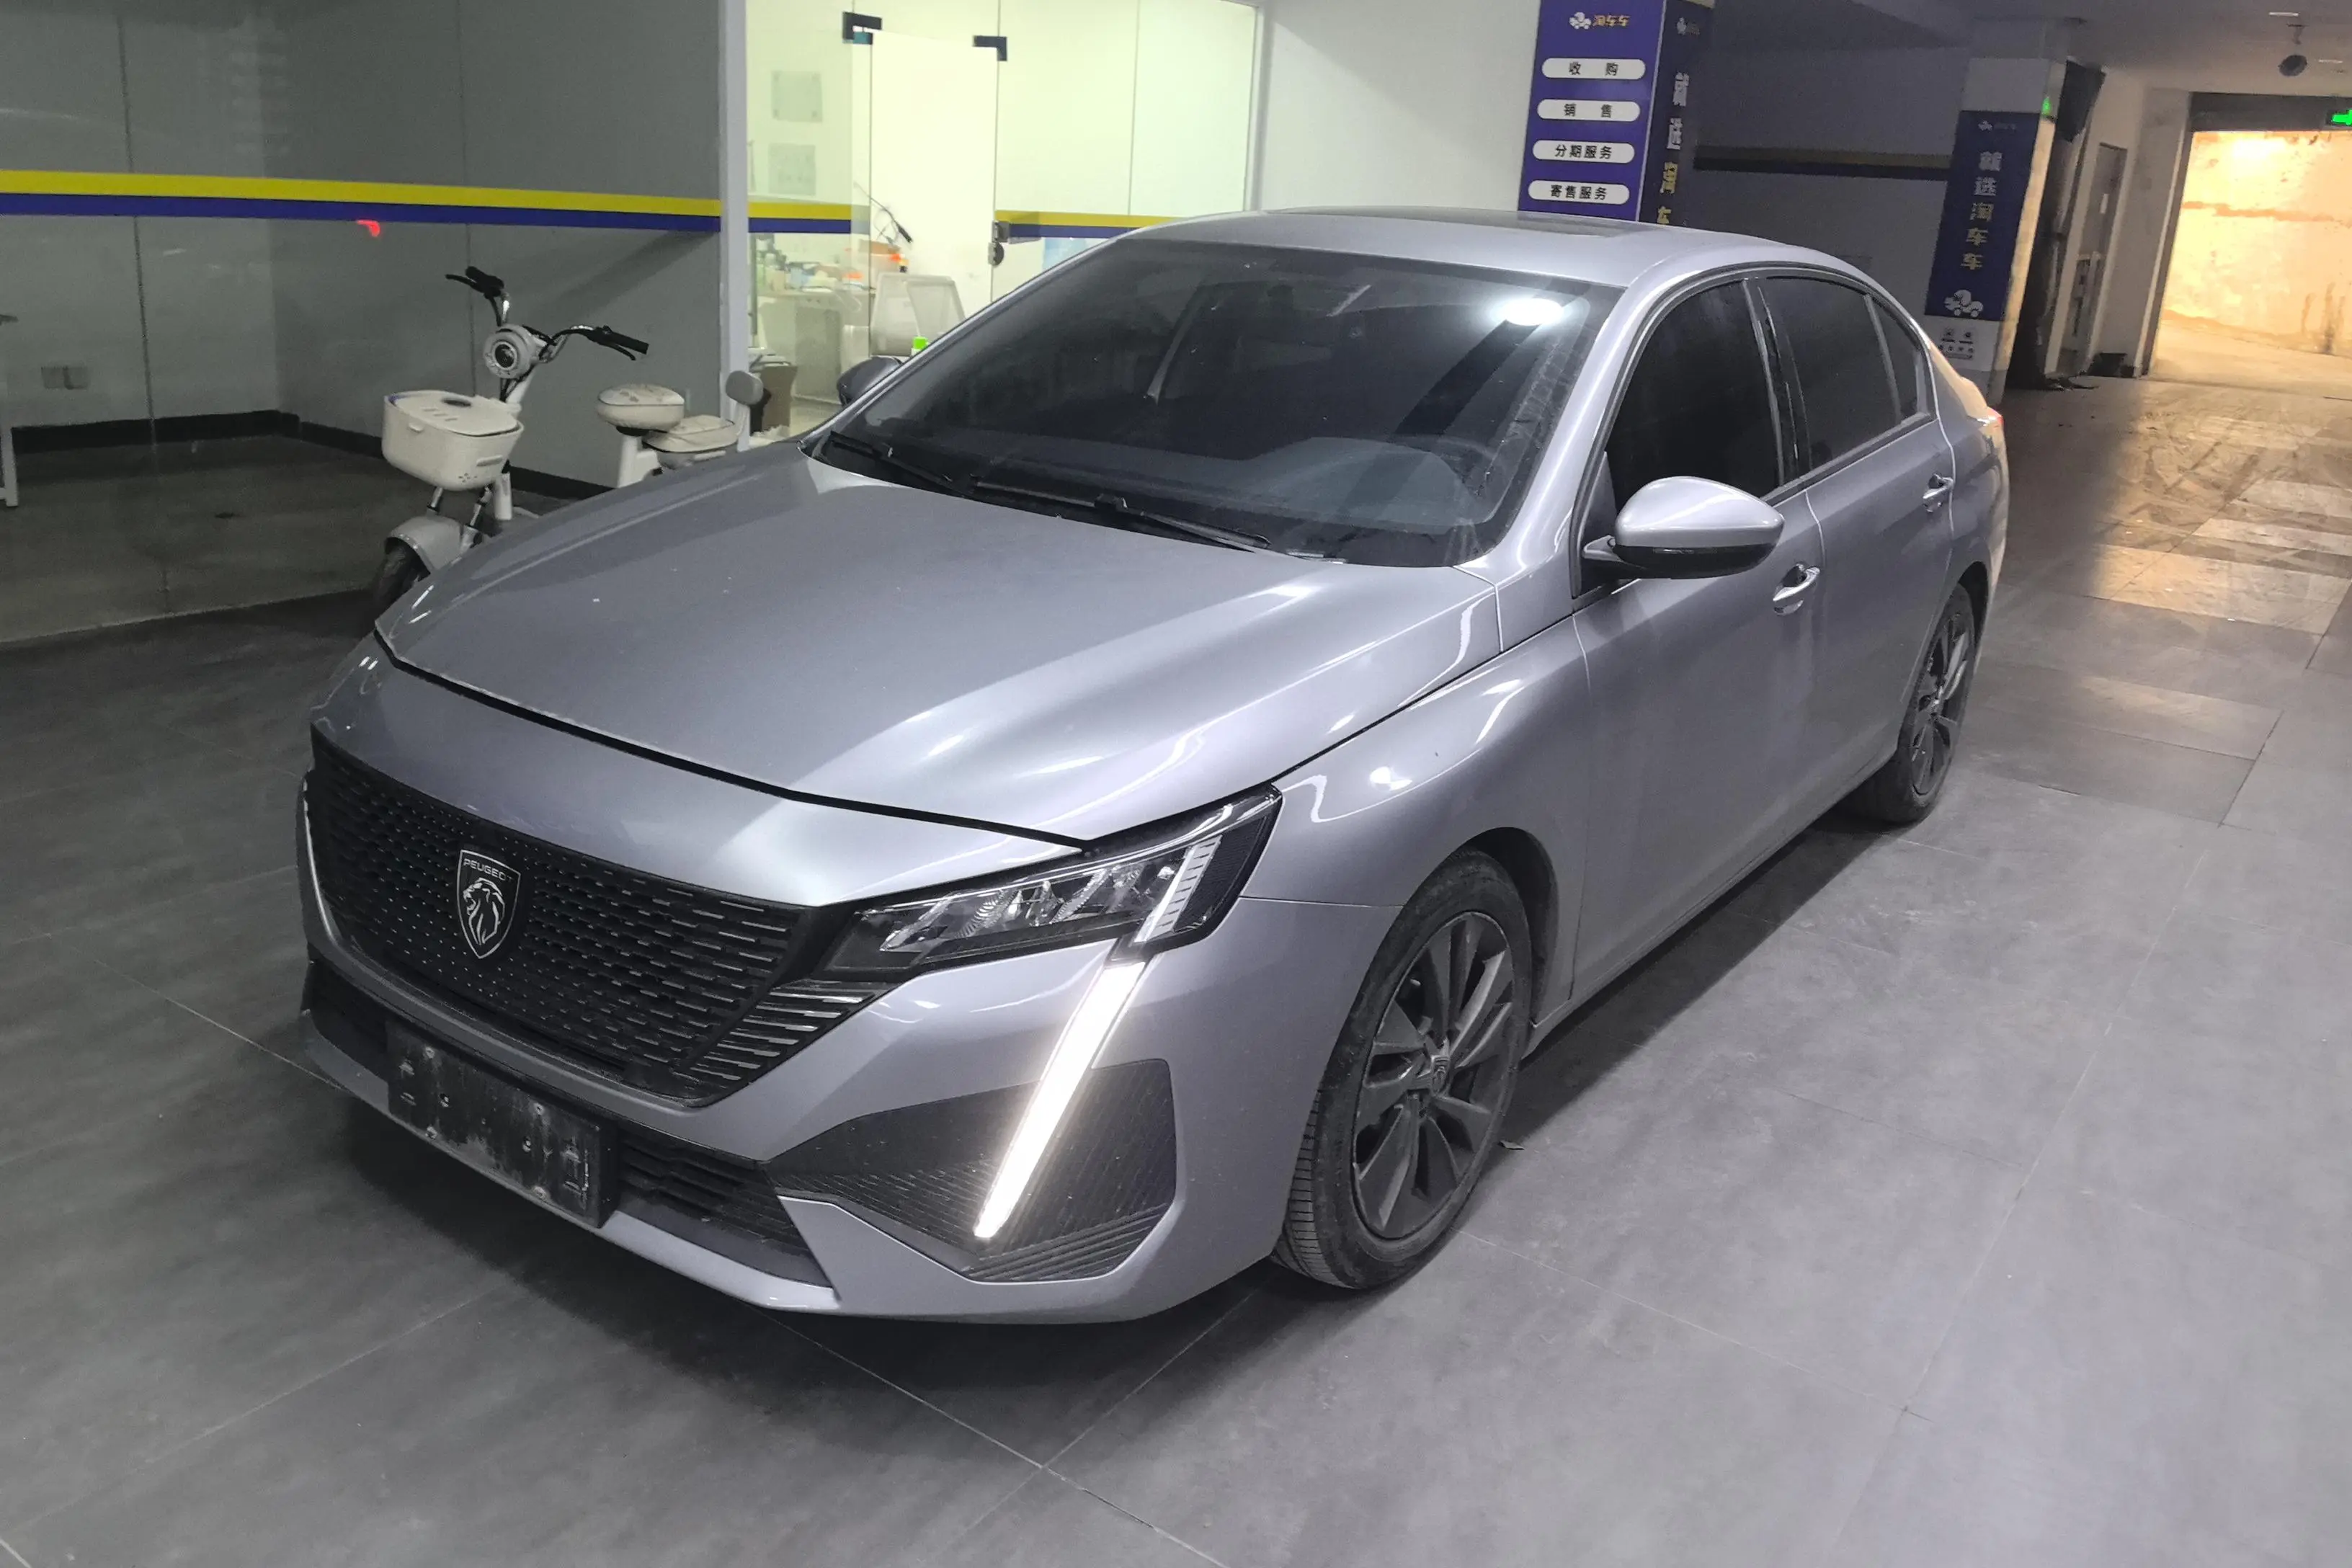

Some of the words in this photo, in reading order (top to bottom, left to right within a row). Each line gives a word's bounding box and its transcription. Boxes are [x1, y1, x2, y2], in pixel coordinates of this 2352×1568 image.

[1555, 144, 1613, 159] 分期服务
[1551, 184, 1608, 201] 寄售服务
